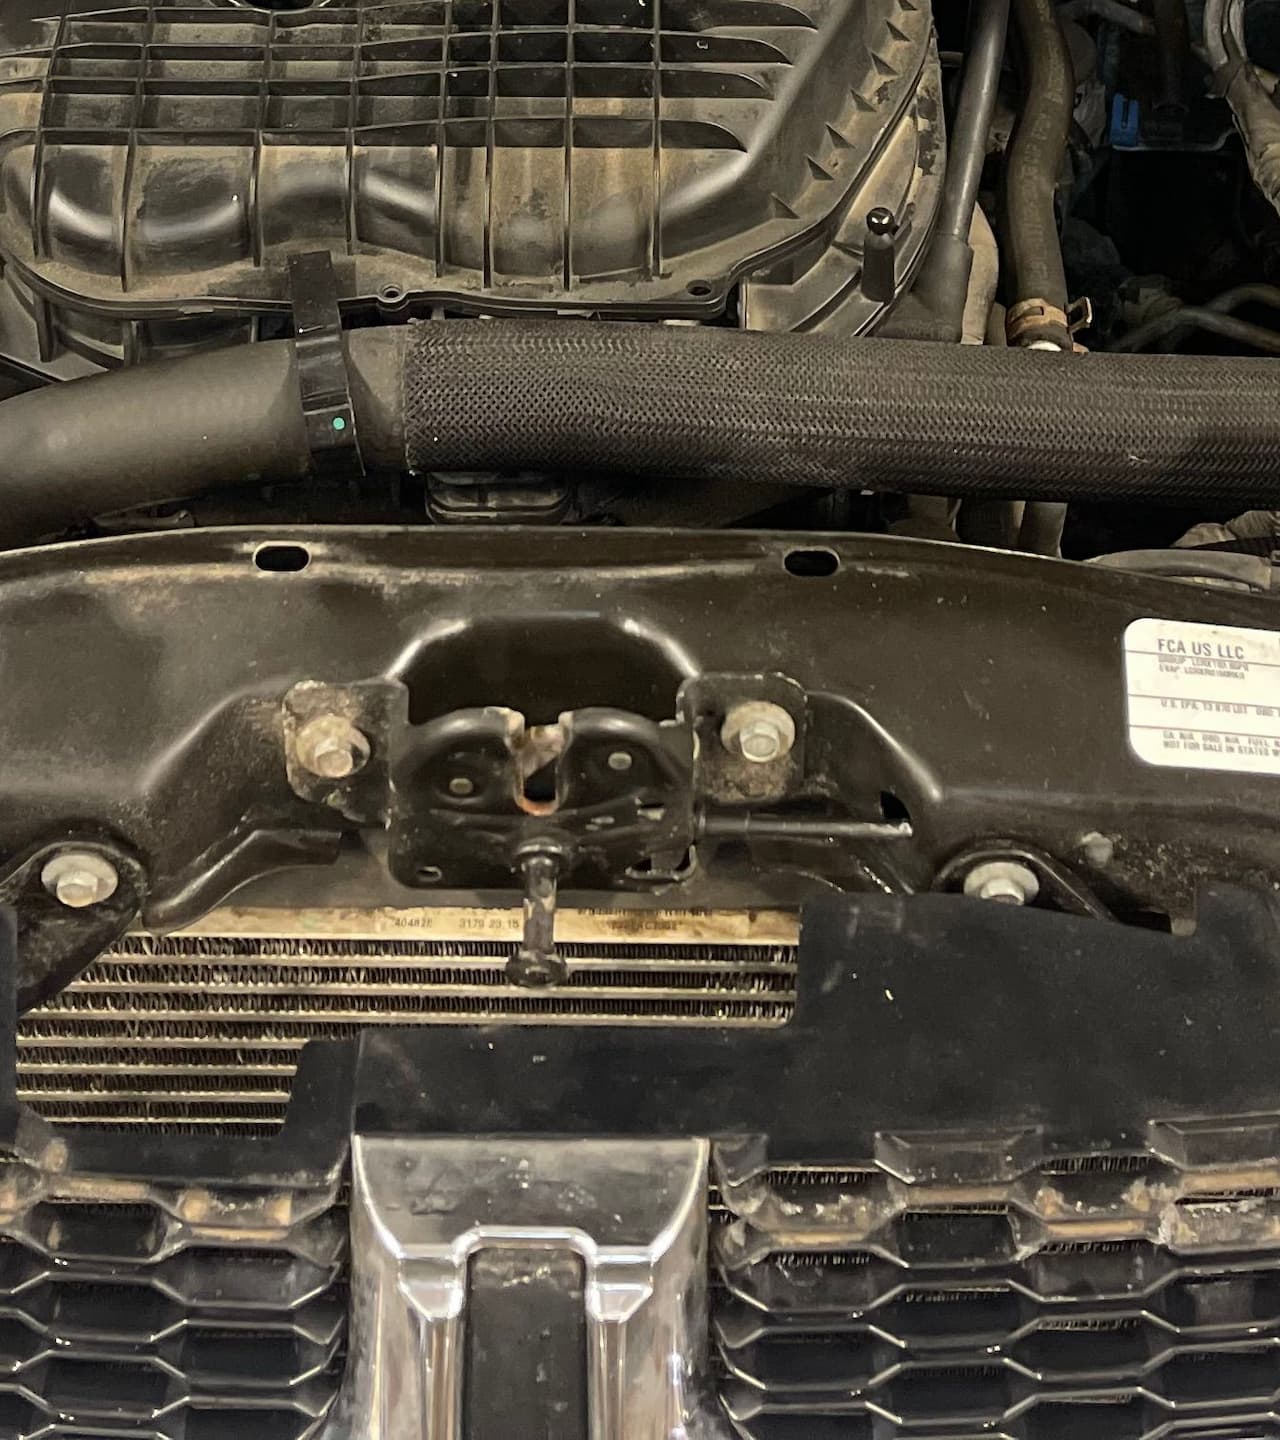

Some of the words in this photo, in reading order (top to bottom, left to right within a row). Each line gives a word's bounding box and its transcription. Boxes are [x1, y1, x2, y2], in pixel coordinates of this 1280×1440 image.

[1157, 638, 1186, 654] FCA
[1191, 641, 1212, 657] US
[1217, 643, 1244, 660] LLC
